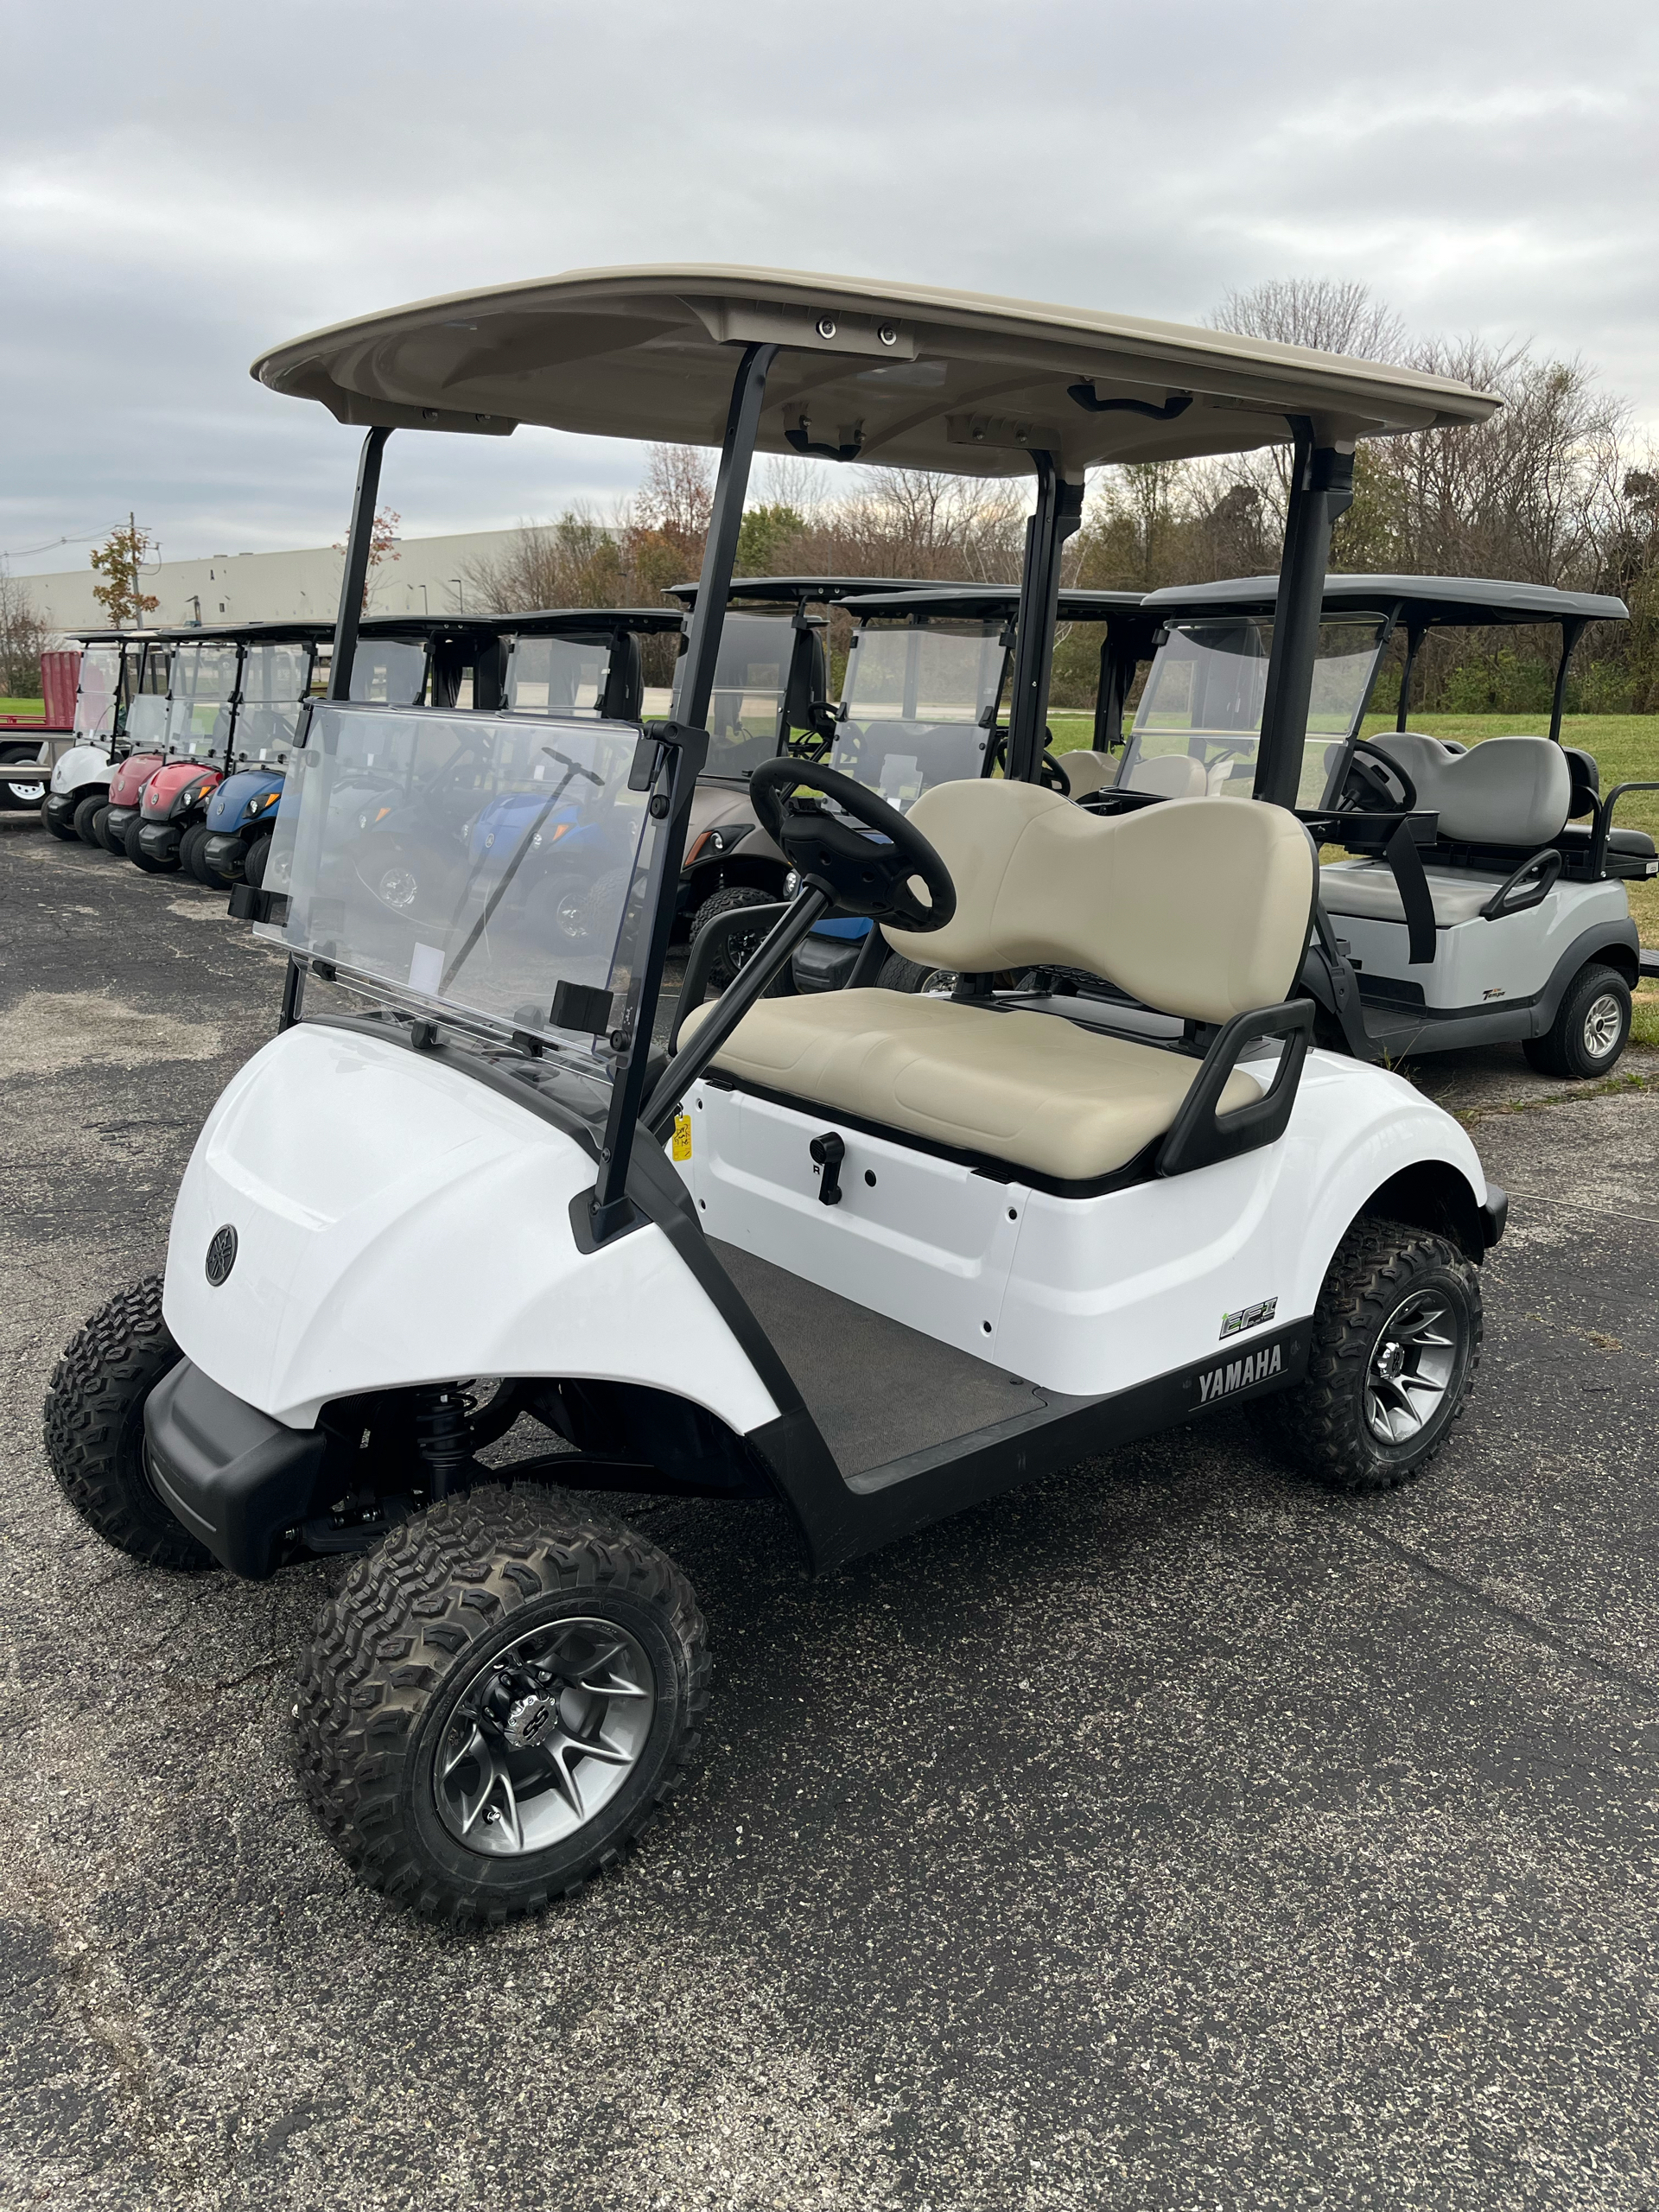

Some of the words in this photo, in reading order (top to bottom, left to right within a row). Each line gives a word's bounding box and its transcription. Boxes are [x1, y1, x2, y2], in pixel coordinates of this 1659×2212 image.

[813, 1165, 821, 1175] R
[1220, 1298, 1277, 1338] EFI
[1199, 1344, 1281, 1403] YAMAHA
